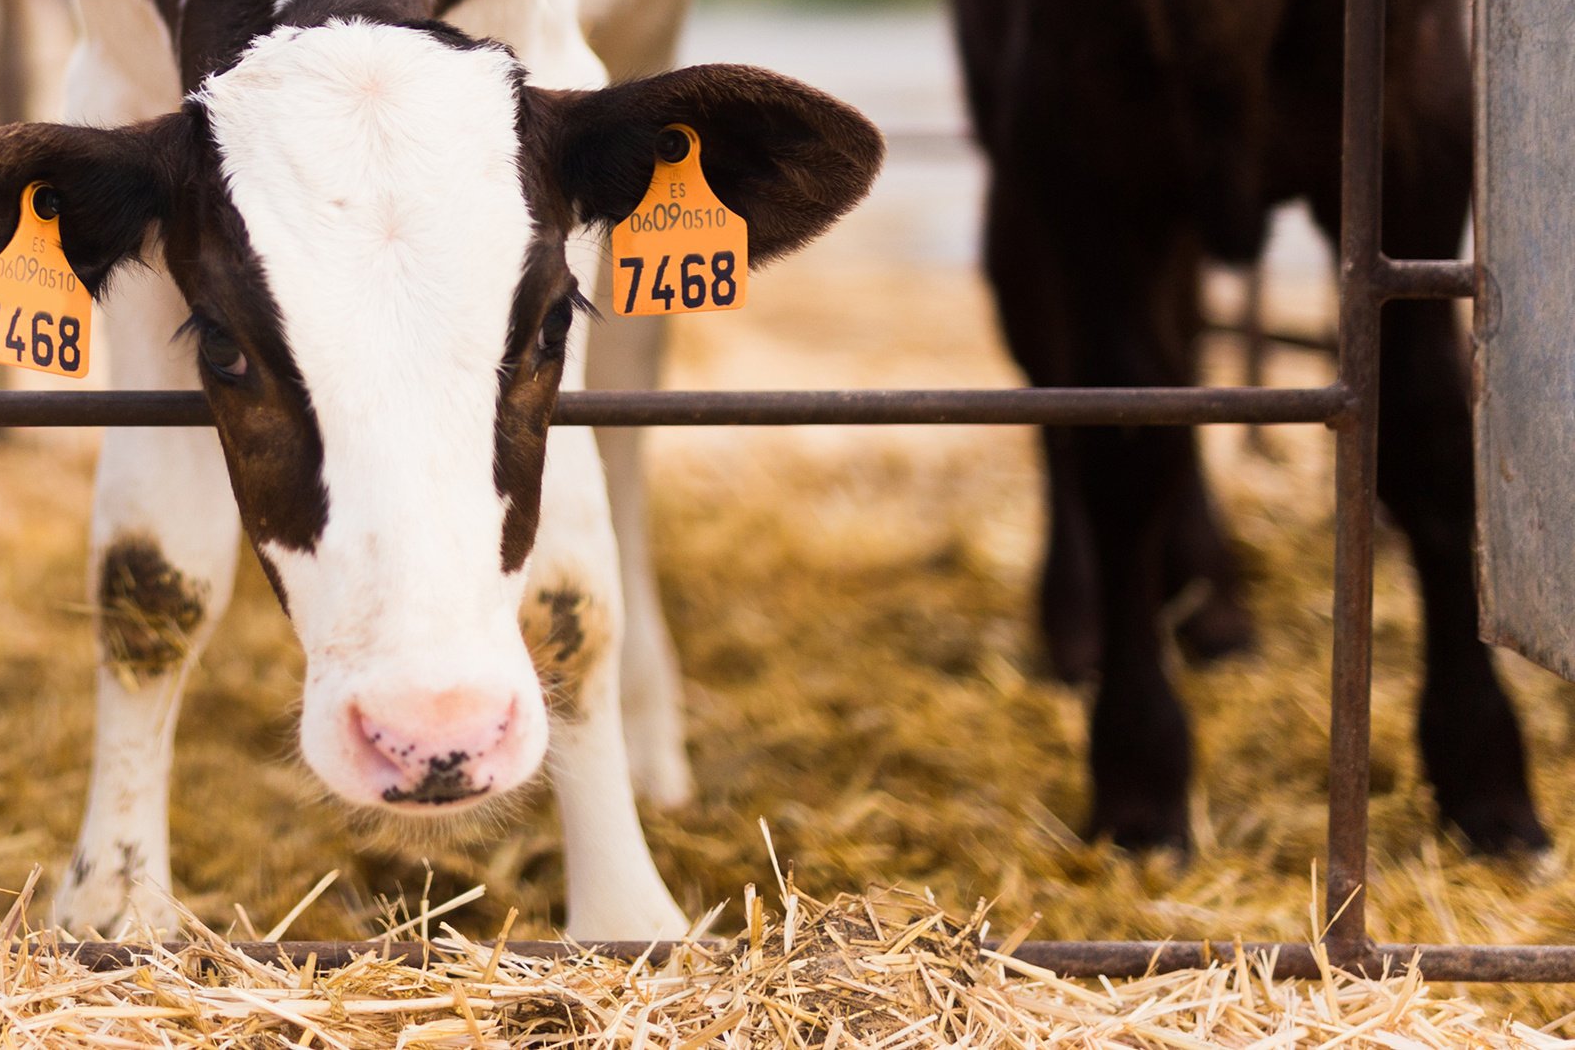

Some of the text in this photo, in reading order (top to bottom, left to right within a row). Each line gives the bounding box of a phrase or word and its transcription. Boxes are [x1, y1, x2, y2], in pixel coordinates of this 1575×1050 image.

[670, 182, 686, 199] ES
[630, 202, 726, 234] 06090510
[32, 236, 46, 254] ES
[619, 250, 737, 314] 7468
